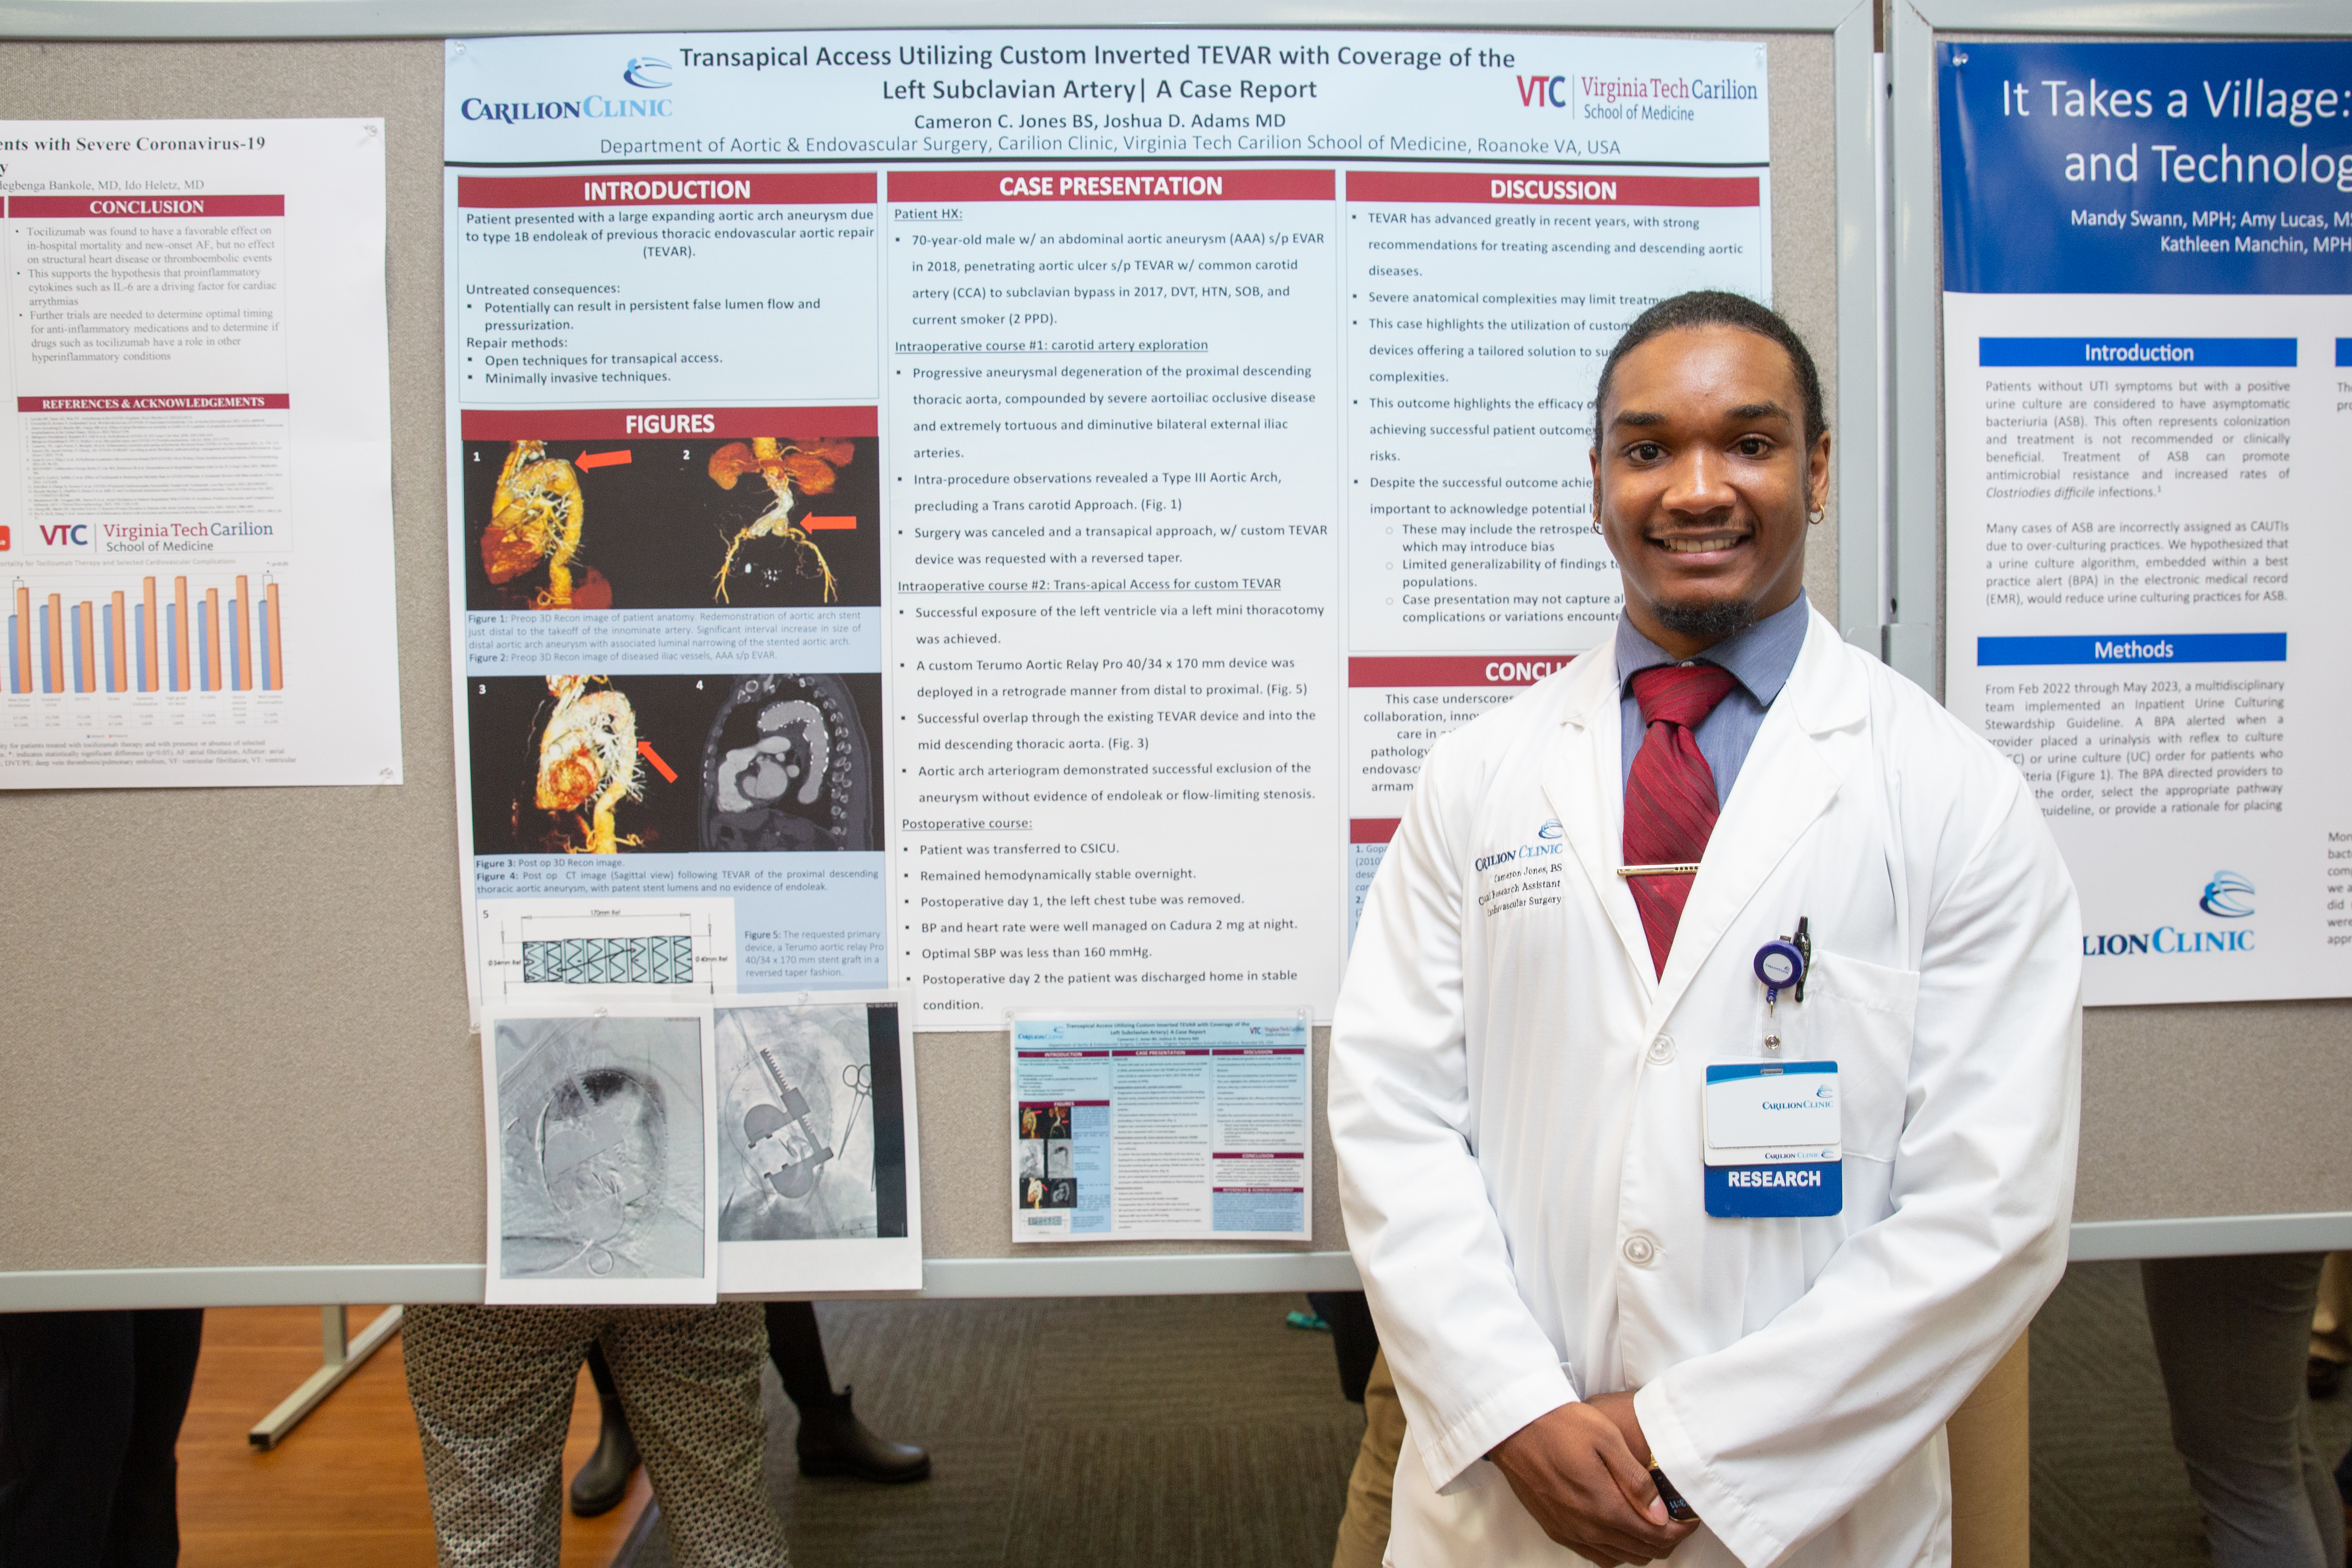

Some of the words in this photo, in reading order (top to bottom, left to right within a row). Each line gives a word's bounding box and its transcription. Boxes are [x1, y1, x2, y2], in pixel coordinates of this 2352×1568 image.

[680, 46, 807, 71] Transapical
[816, 47, 891, 65] Access
[900, 45, 992, 69] Utilizing
[1000, 45, 1085, 64] Custom
[1095, 44, 1189, 64] Inverted
[1198, 45, 1271, 64] TEVAR
[1279, 45, 1329, 64] with
[1338, 47, 1441, 70] Coverage
[1450, 47, 1472, 66] of
[1479, 48, 1515, 68] the
[884, 80, 925, 99] Left
[933, 79, 1055, 99] Subclavian
[1156, 80, 1172, 98] A
[1180, 80, 1231, 98] Case
[1241, 80, 1317, 102] Report
[1517, 75, 1566, 108] VTC
[1581, 76, 1648, 101] Virginia
[1650, 78, 1689, 98] Tech
[1692, 79, 1758, 100] Carilion
[2004, 80, 2030, 116] It
[2041, 79, 2152, 118] Takes
[2167, 89, 2187, 118] a
[2203, 78, 2351, 127] Village:
[1584, 103, 1622, 119] School
[1626, 104, 1638, 120] of
[1642, 105, 1694, 121] Medicine
[915, 115, 991, 129] Cameron
[998, 114, 1013, 128] C.
[1019, 114, 1066, 128] Jones
[1073, 114, 1098, 131] BS,
[1104, 113, 1161, 128] Joshua
[1169, 114, 1185, 127] D.
[1191, 113, 1249, 128] Adams
[1256, 114, 1285, 127] MD
[34, 138, 70, 151] with
[76, 138, 130, 151] Severe
[136, 137, 265, 150] Coronavirus-19
[601, 139, 702, 156] Department
[708, 137, 725, 152] of
[730, 138, 781, 152] Aortic
[787, 137, 800, 152] &
[807, 136, 918, 152] Endovascular
[924, 136, 992, 154] Surgery,
[998, 135, 1062, 150] Carilion
[1068, 135, 1117, 152] Clinic,
[1123, 136, 1186, 153] Virginia
[1192, 135, 1231, 150] Tech
[1238, 134, 1301, 149] Carilion
[1308, 134, 1362, 149] School
[1368, 135, 1385, 150] of
[1391, 136, 1471, 154] Medicine,
[1478, 138, 1549, 153] Roanoke
[1554, 139, 1581, 156] VA,
[1588, 140, 1621, 154] USA
[2065, 143, 2138, 182] and
[49, 180, 94, 191] Bankole,
[98, 181, 121, 191] MD,
[125, 180, 142, 190] Ido
[145, 180, 180, 190] Heletz,
[185, 180, 204, 189] MD
[585, 180, 750, 200] INTRODUCTION
[1000, 177, 1053, 196] CASE
[1060, 176, 1222, 195] PRESENTATION
[1491, 180, 1617, 200] DISCUSSION
[90, 200, 203, 214] CONCLUSION
[895, 209, 937, 219] Patient
[942, 209, 962, 218] HX:
[2071, 209, 2127, 229] Mandy
[2131, 210, 2187, 229] Swann,
[2192, 211, 2236, 229] MPH;
[2241, 211, 2276, 230] Amy
[2281, 212, 2328, 229] Lucas,
[26, 227, 85, 236] Tocilizumab
[110, 227, 137, 236] found
[152, 227, 174, 236] have
[185, 226, 228, 235] favorable
[230, 226, 257, 235] effect
[2161, 235, 2230, 252] Kathleen
[2235, 236, 2308, 254] Manchin,
[2086, 343, 2194, 361] Introduction
[1986, 381, 2031, 391] Patients
[2038, 380, 2083, 391] without
[2090, 380, 2108, 391] UTI
[2115, 382, 2172, 393] symptoms
[2179, 380, 2198, 391] but
[2204, 380, 2229, 391] with
[2235, 383, 2241, 391] a
[2248, 381, 2290, 393] positive
[43, 399, 119, 409] REFERENCES
[121, 399, 130, 408] &
[133, 397, 265, 408] ACKNOWLEDGEMENTS
[626, 414, 715, 434] FIGURES
[474, 452, 480, 461] 1
[683, 450, 690, 460] 2
[40, 524, 87, 545] VTC
[103, 523, 169, 541] Virginia
[171, 522, 208, 536] Tech
[211, 521, 273, 536] Carilion
[106, 541, 144, 552] School
[148, 541, 160, 552] of
[163, 541, 213, 551] Medicine
[2095, 640, 2174, 659] Methods
[1485, 662, 1570, 681] CONCL
[479, 684, 486, 694] 3
[476, 860, 505, 869] Figure
[508, 859, 515, 867] 3:
[554, 858, 565, 867] 3D
[596, 859, 624, 868] image.
[921, 870, 980, 881] Remained
[985, 869, 1091, 882] hemodynamically
[1095, 869, 1131, 879] stable
[1135, 868, 1196, 881] overnight.
[1494, 871, 1521, 882] Cameron
[1524, 867, 1548, 875] Jones,
[1550, 864, 1562, 872] BS
[1522, 880, 1560, 891] Assistant
[1529, 896, 1561, 905] Surgery
[1728, 1170, 1821, 1187] RESEARCH
